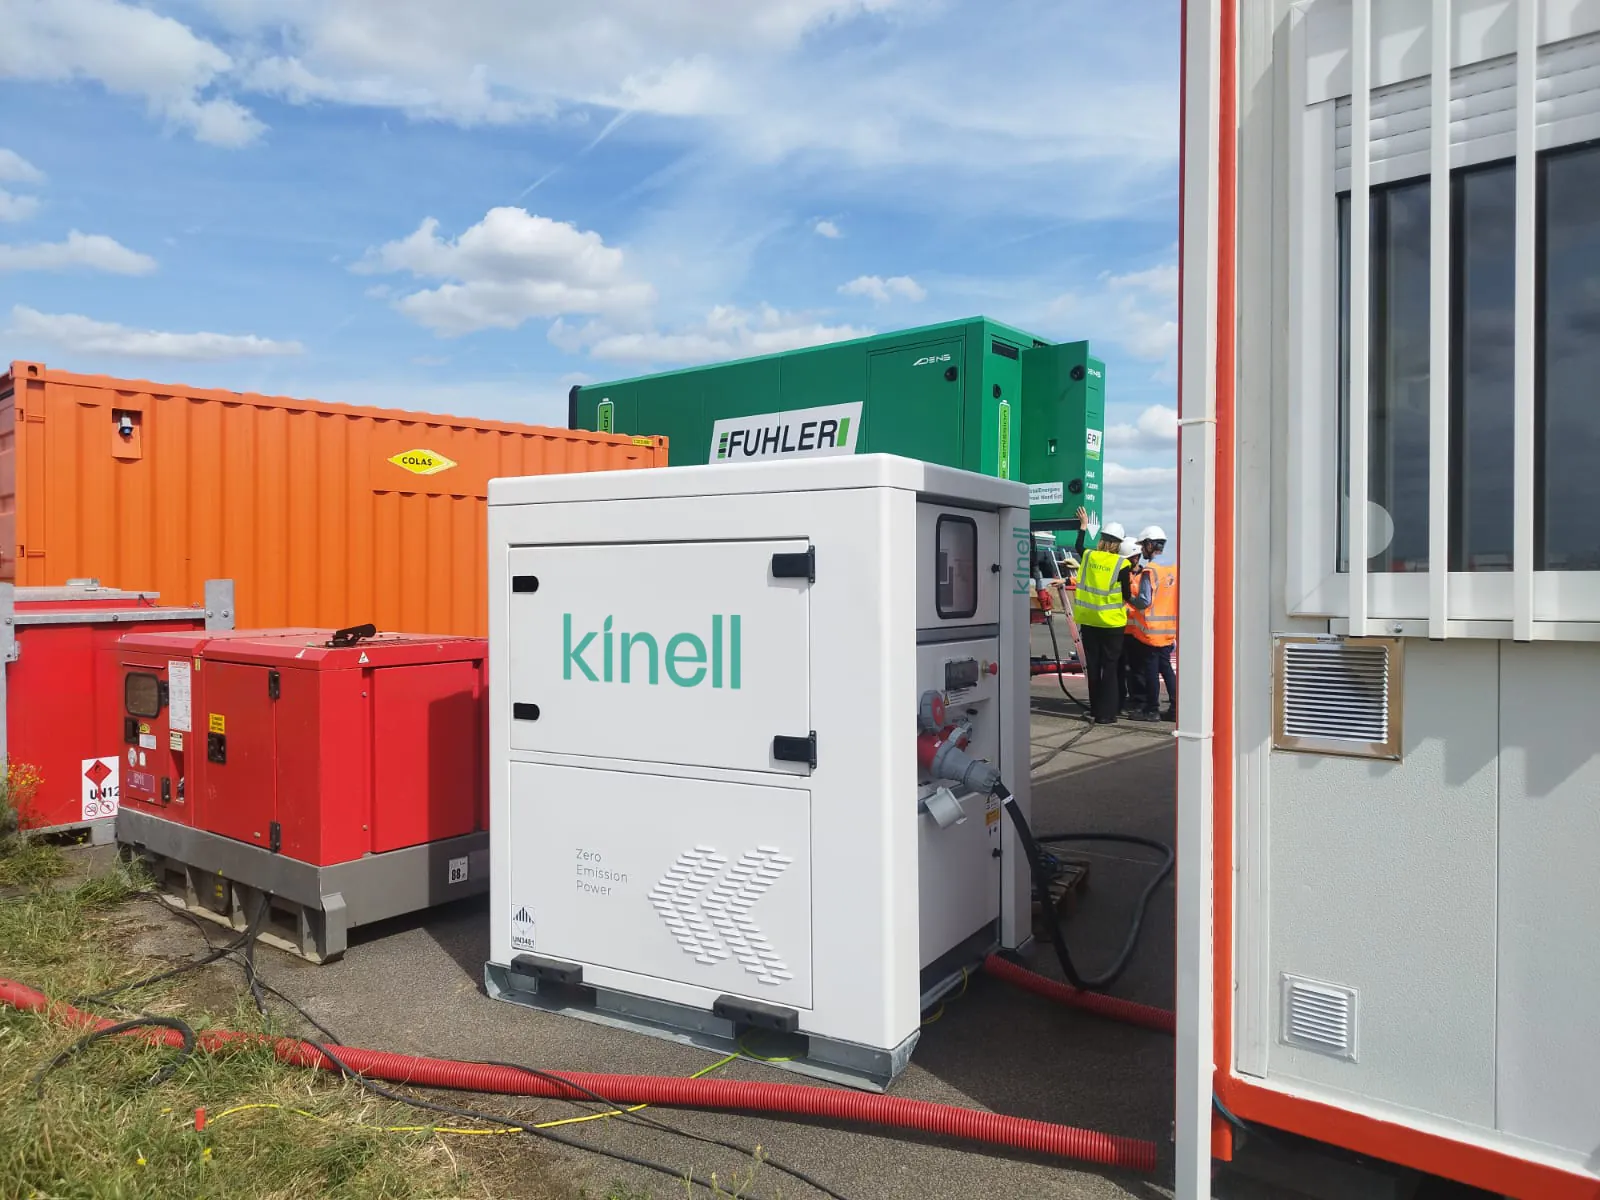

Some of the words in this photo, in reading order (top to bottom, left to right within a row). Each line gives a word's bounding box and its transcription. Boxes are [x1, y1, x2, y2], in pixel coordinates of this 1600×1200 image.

[727, 419, 838, 458] FUHLER
[401, 456, 433, 466] COLAS
[1013, 527, 1030, 594] kinell
[563, 613, 741, 690] kinell
[575, 848, 602, 862] Zero
[576, 863, 628, 884] Emission
[576, 879, 612, 896] Power
